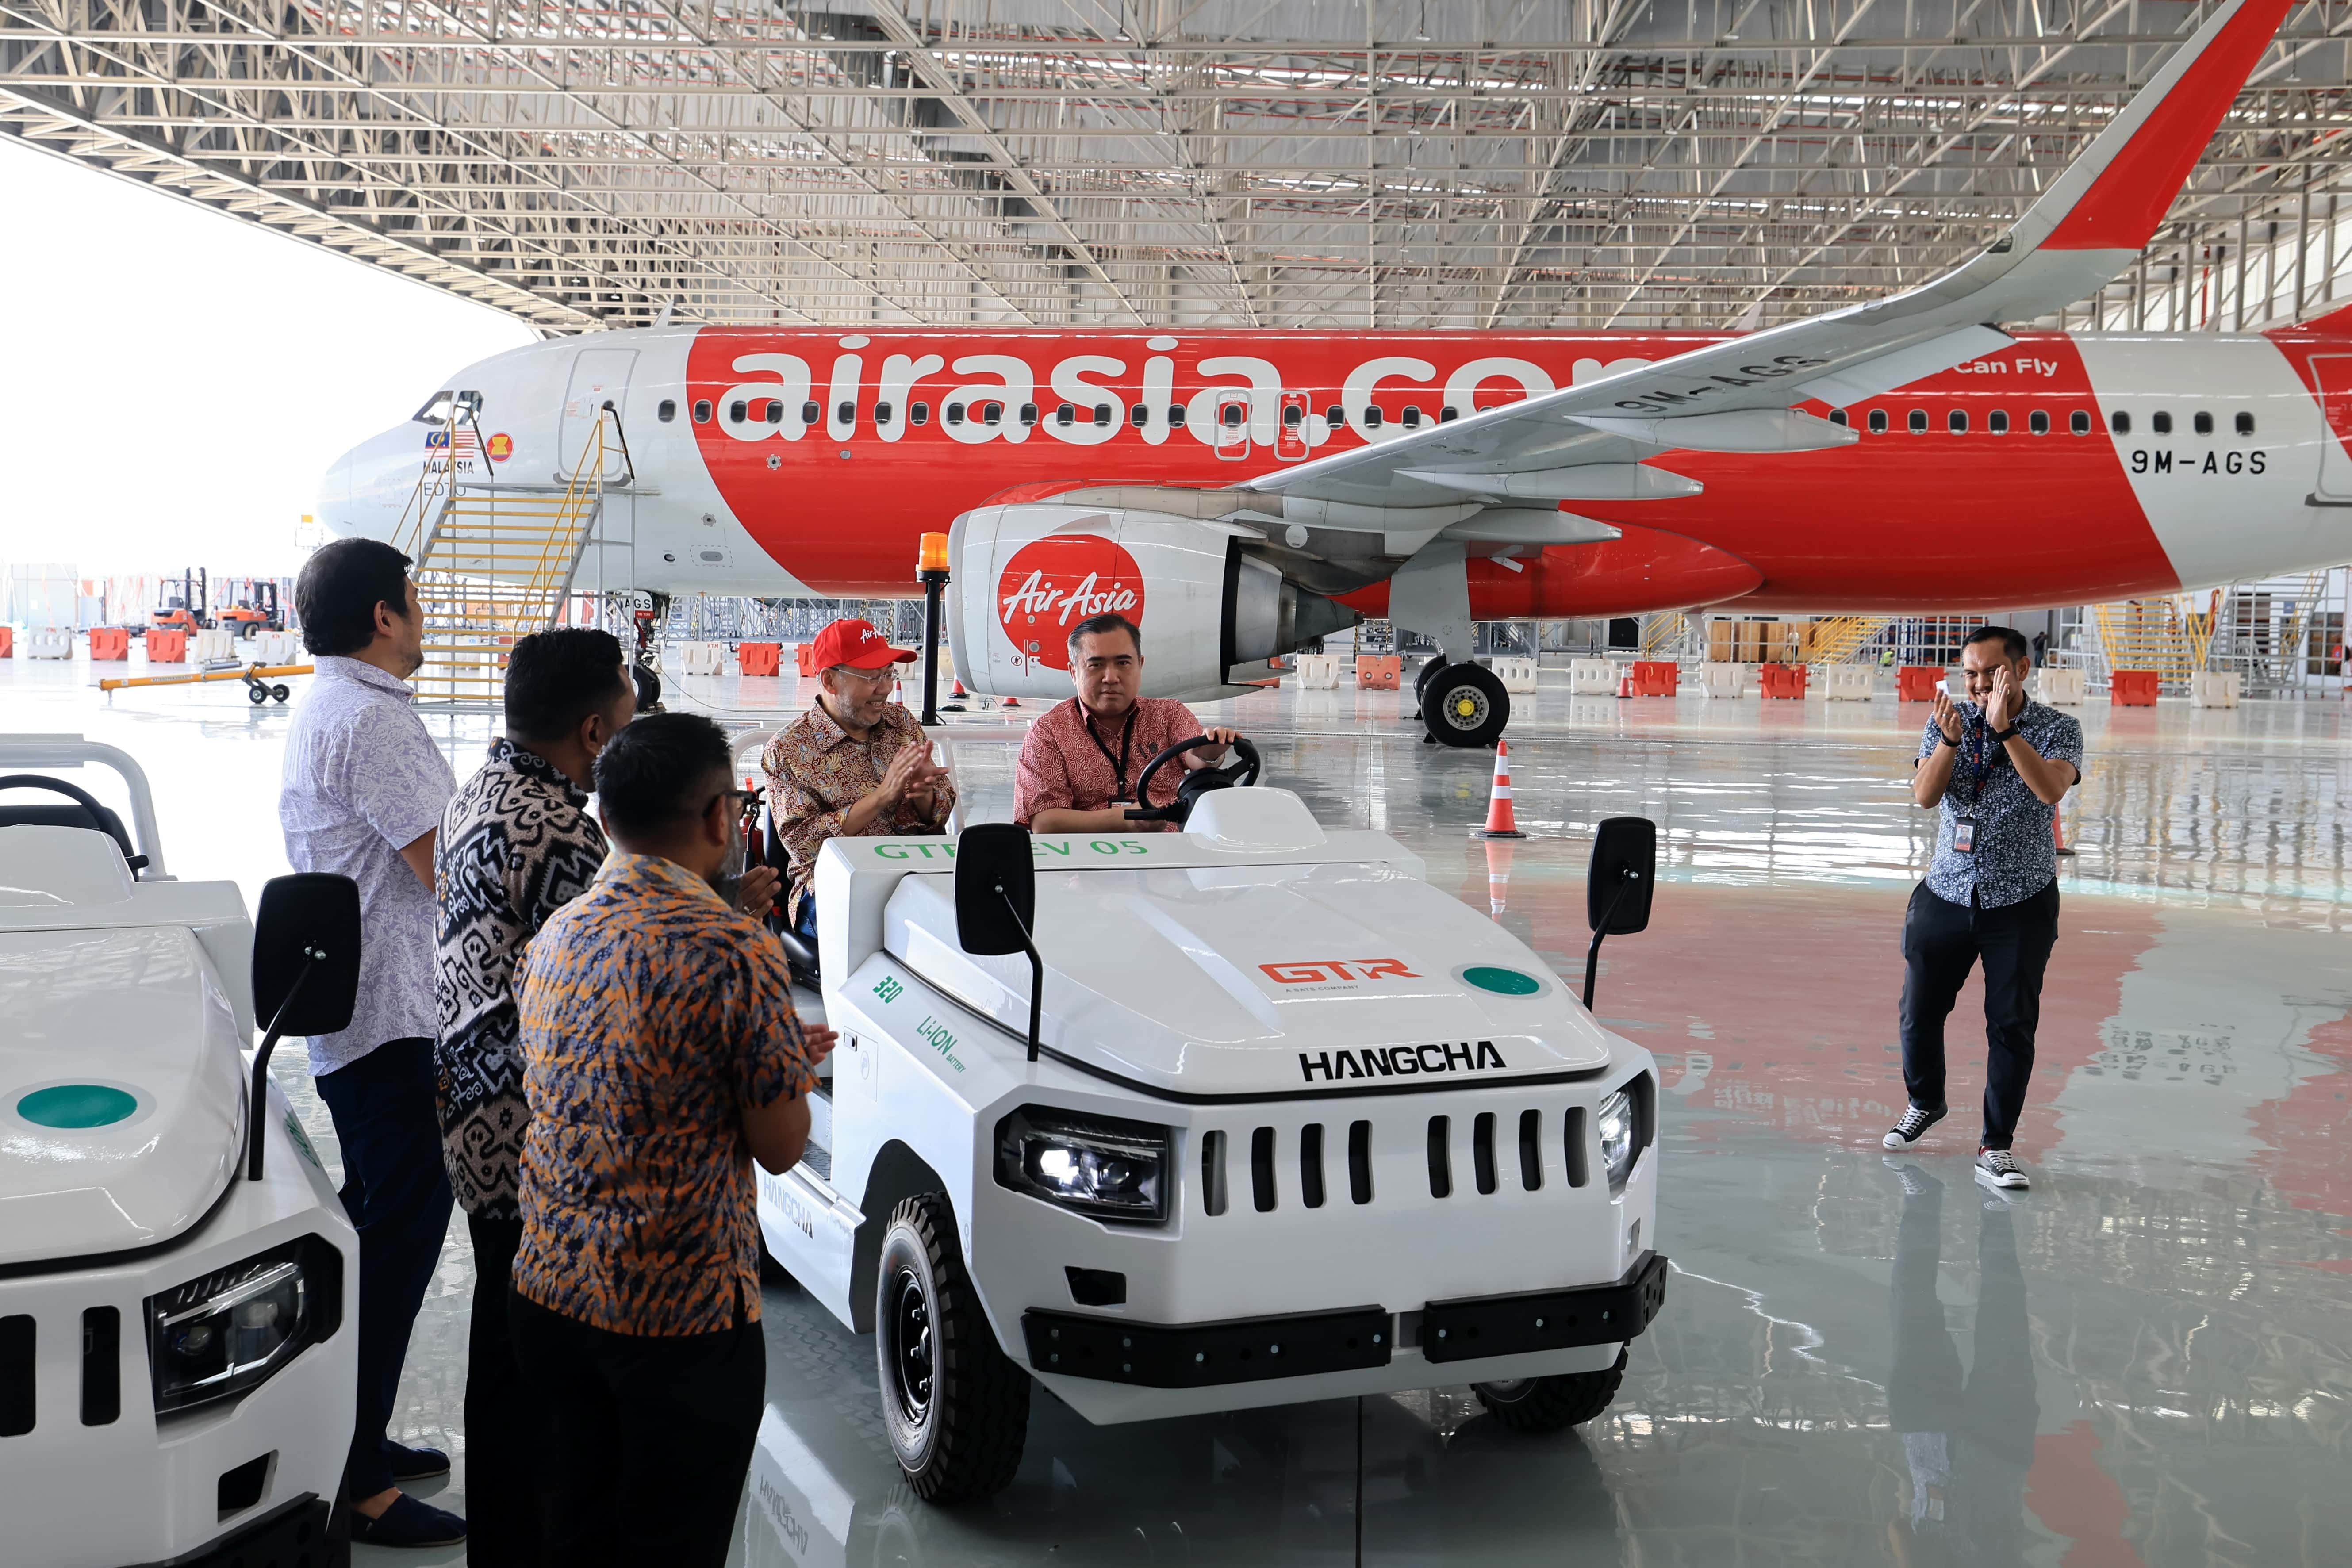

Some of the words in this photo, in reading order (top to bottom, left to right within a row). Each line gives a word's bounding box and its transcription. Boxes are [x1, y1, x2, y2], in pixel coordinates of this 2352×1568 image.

[2015, 358, 2058, 377] Fly
[717, 335, 1657, 445] airasia.co
[423, 461, 474, 474] MALASIA
[2131, 450, 2266, 475] 9M-AGS
[1090, 841, 1148, 855] 05
[1258, 958, 1425, 983] GTR
[873, 976, 904, 1004] 320
[946, 1054, 966, 1073] BATTERY
[1299, 1041, 1506, 1082] HANGCHA
[764, 1173, 813, 1240] HANGCHA
